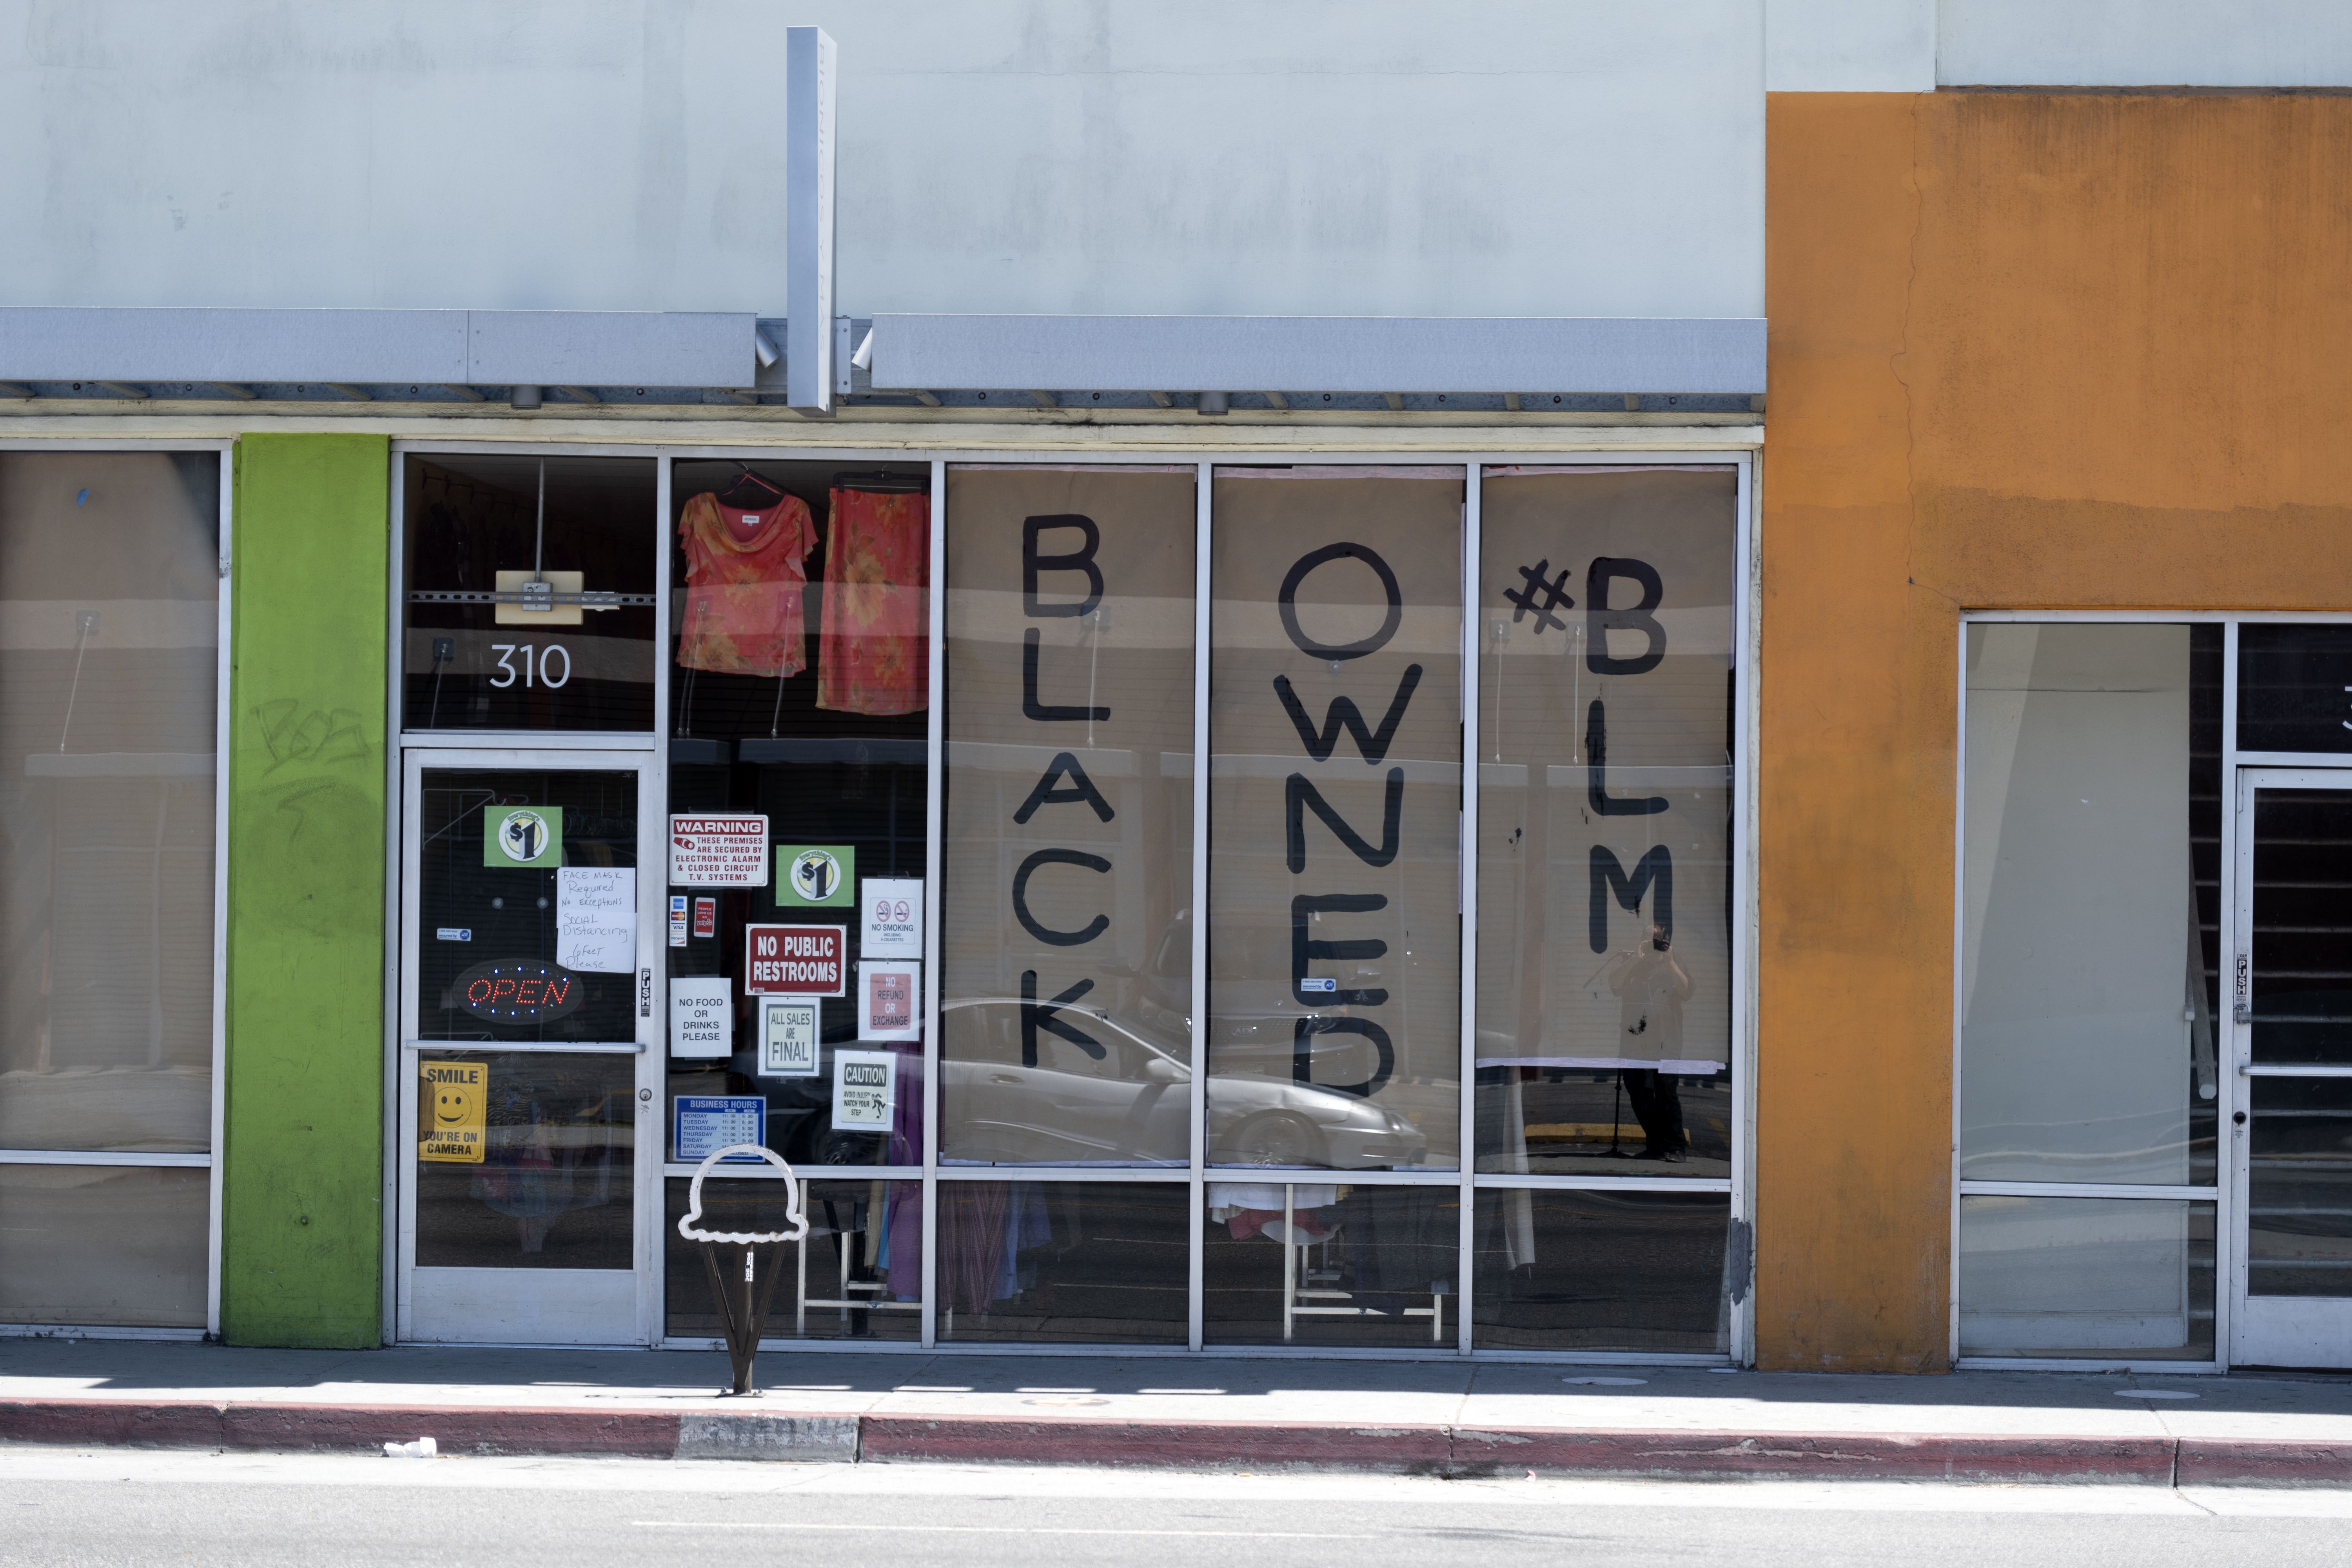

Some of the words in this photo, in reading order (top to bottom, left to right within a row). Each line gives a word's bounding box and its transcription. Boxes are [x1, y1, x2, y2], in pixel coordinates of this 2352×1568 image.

[490, 644, 570, 688] 310
[1503, 557, 1672, 955] #BLM
[1013, 514, 1114, 1067] BLACK
[507, 811, 540, 822] Everything's
[1273, 542, 1423, 1101] OWNED
[675, 822, 761, 833] WARNING
[508, 820, 536, 860] $1
[799, 850, 832, 861] Everything's
[563, 871, 588, 880] FACE
[800, 860, 828, 899] $1
[566, 880, 614, 898] Required
[757, 936, 777, 956] NO
[784, 936, 833, 957] PUBLIC
[566, 956, 607, 969] Please
[753, 961, 837, 982] RESTROOMS
[2238, 960, 2246, 994] PUSH
[886, 976, 896, 987] NO
[468, 979, 569, 1004] OPEN
[877, 990, 904, 1000] REFUND
[885, 1003, 895, 1013] OR
[771, 1013, 785, 1025] ALL
[786, 1013, 810, 1025] SALES
[873, 1016, 908, 1025] EXCHANGE
[786, 1027, 795, 1039] ARE
[772, 1042, 809, 1061] FINAL
[426, 1069, 478, 1084] SMILE
[845, 1066, 886, 1083] CAUTION
[690, 1100, 729, 1108] BUSINESS
[731, 1100, 757, 1109] HOURS
[423, 1131, 460, 1142] YOU'RE
[463, 1132, 477, 1142] ON
[427, 1143, 472, 1155] CAMERA
